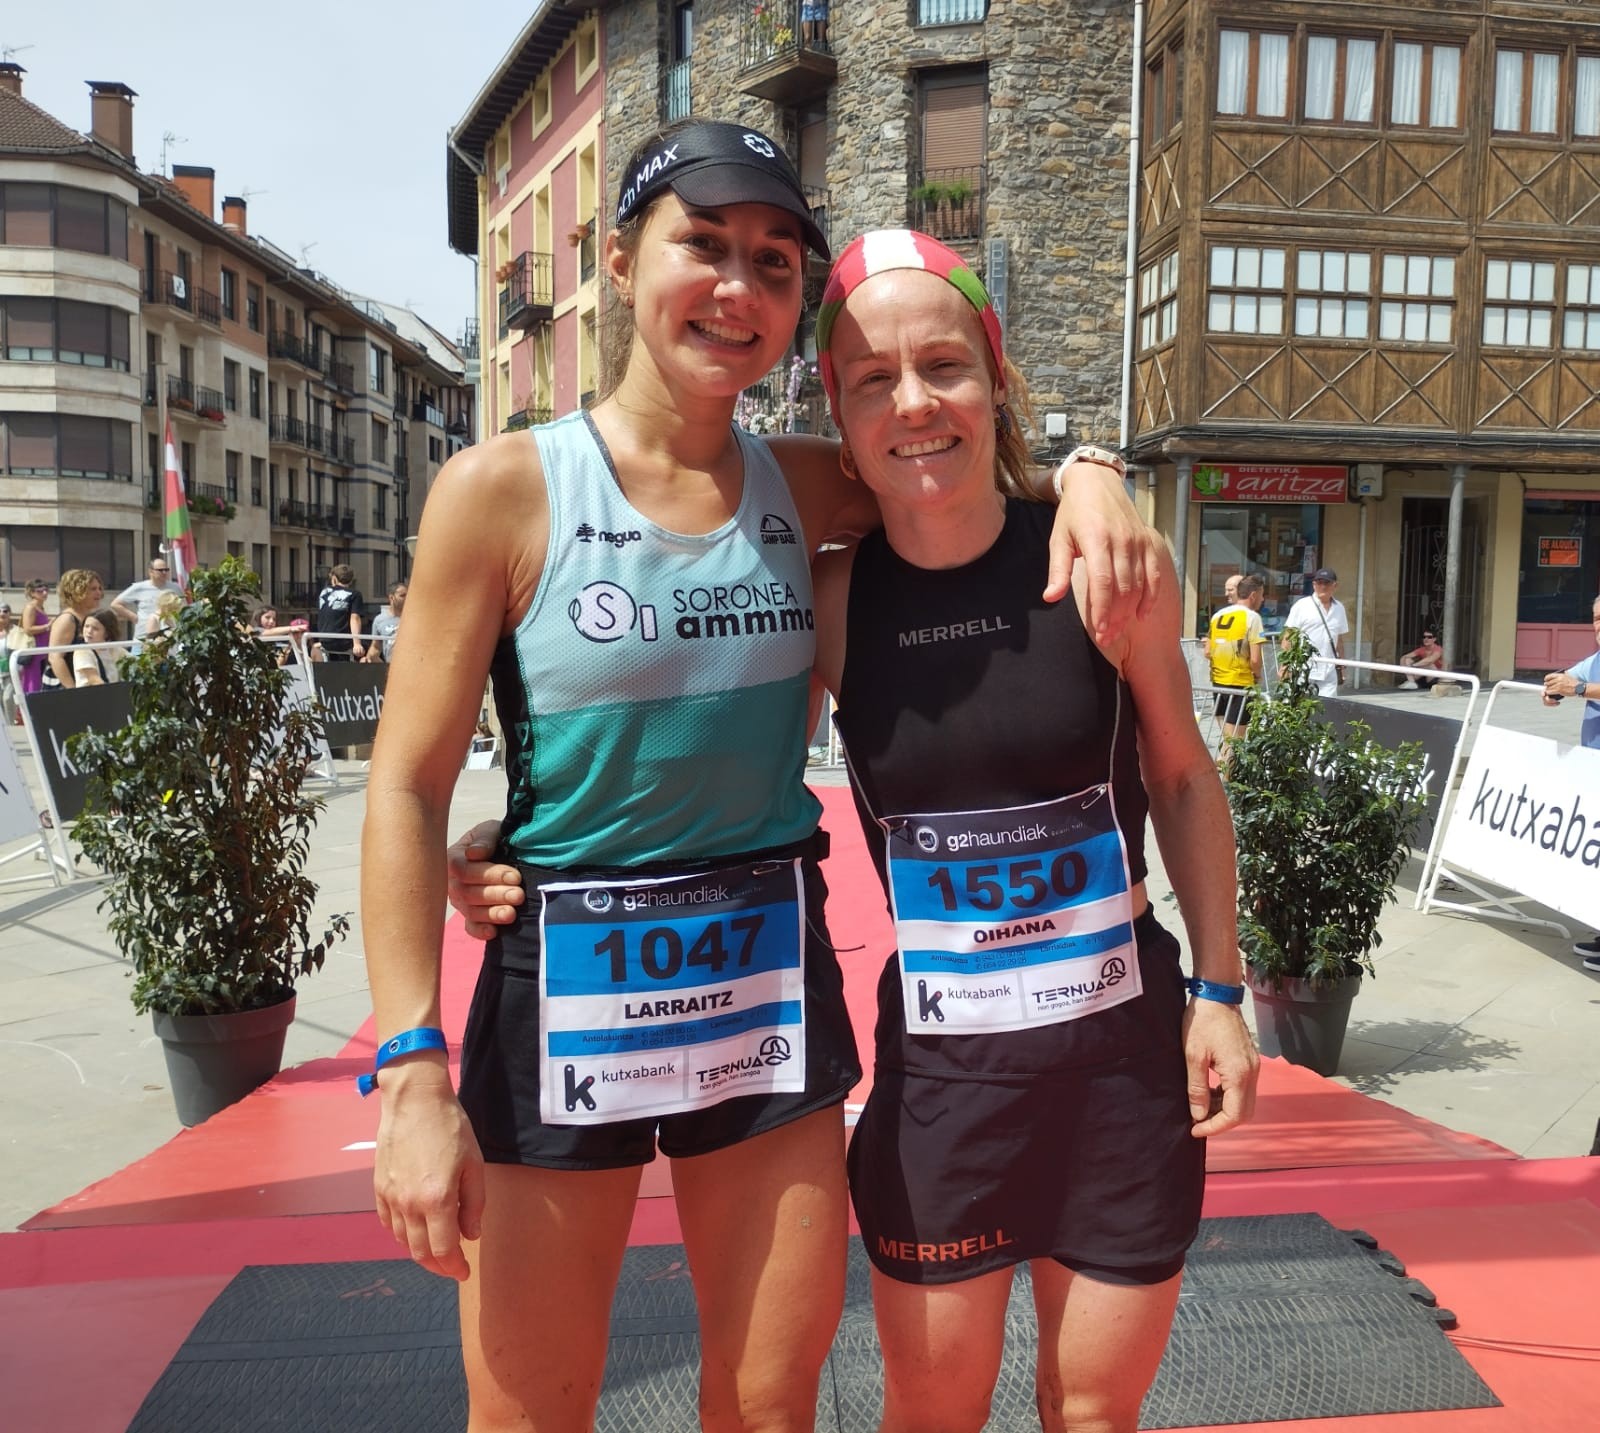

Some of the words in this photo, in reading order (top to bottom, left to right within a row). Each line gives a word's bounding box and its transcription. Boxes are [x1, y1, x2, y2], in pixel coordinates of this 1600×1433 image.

[636, 143, 680, 193] MAX
[990, 241, 1005, 324] BELA
[1238, 466, 1300, 474] DIETETIKA
[1238, 493, 1318, 501] BELARDENDA
[598, 528, 642, 548] negua
[673, 581, 798, 613] SORONEA
[898, 615, 1011, 648] MERRELL
[946, 823, 1048, 852] g2haundiak
[927, 851, 1089, 912] 1550
[623, 884, 729, 912] g2haundiak
[973, 919, 1057, 944] OIHANA
[594, 913, 766, 983] 1047
[624, 990, 733, 1020] LARRAITZ
[947, 984, 1012, 1000] kutxabank
[1032, 980, 1106, 1003] TERNUA
[602, 1062, 676, 1083] kutxabank
[696, 1056, 764, 1083] TERNUA
[878, 1229, 1013, 1262] MERRELL
